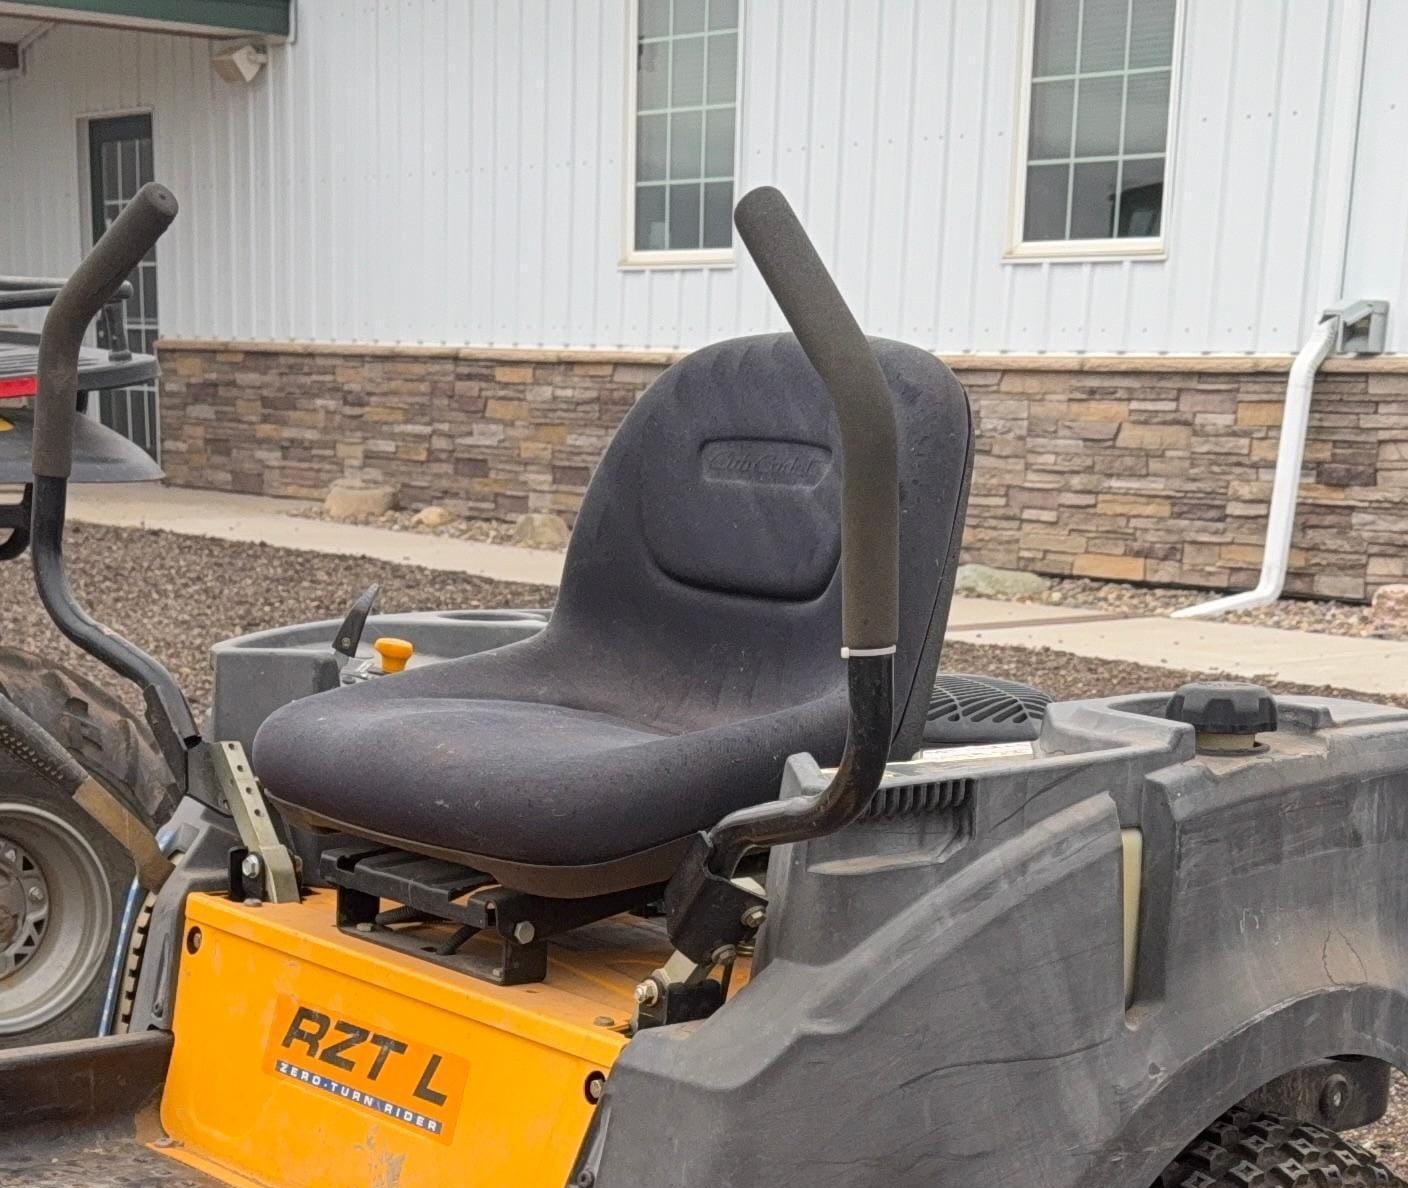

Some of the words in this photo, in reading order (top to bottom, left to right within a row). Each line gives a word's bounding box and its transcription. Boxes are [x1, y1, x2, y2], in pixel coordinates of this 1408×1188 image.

[281, 1006, 409, 1081] RZT
[413, 1054, 448, 1107] L
[383, 1103, 437, 1132] RIDER
